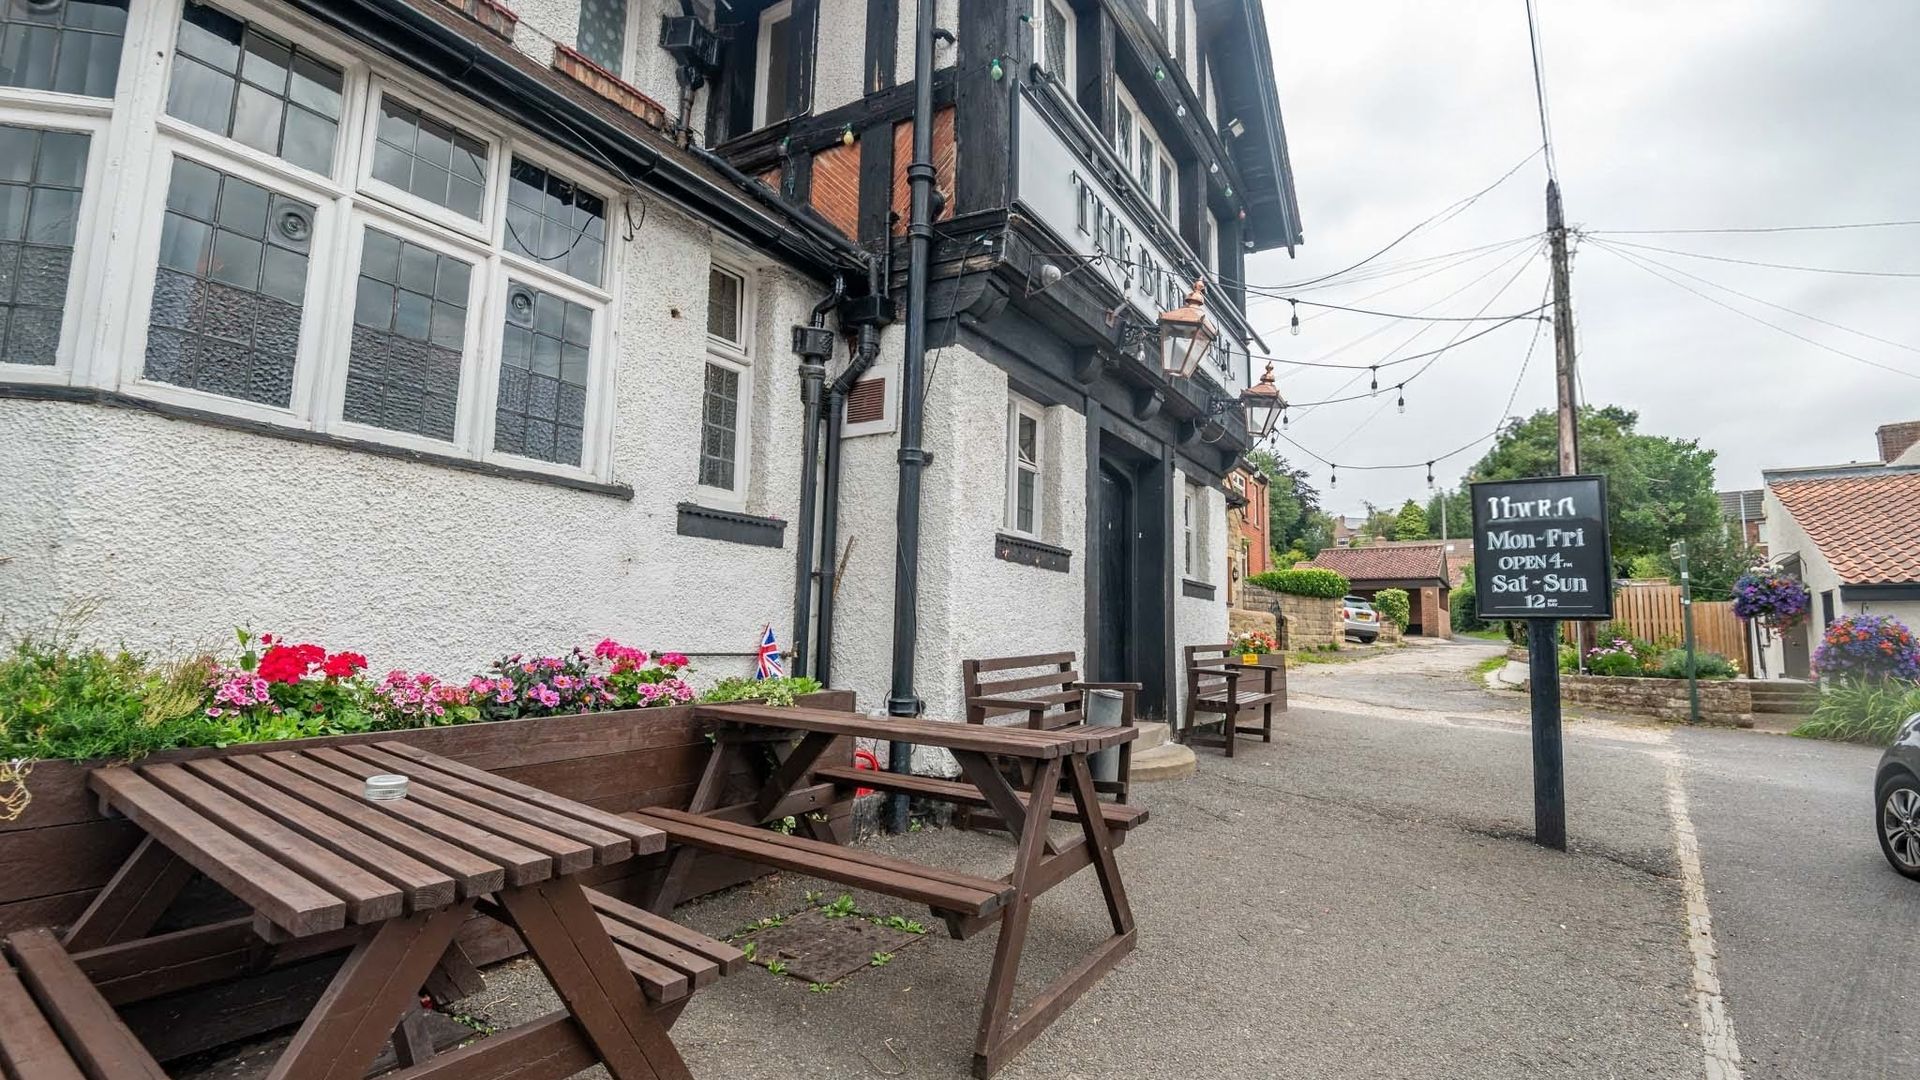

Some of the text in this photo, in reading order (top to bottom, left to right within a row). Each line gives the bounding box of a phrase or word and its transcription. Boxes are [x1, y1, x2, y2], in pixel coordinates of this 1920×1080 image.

[1072, 169, 1134, 281] THE
[1499, 555, 1547, 570] OPEN
[1524, 594, 1546, 608] 12
